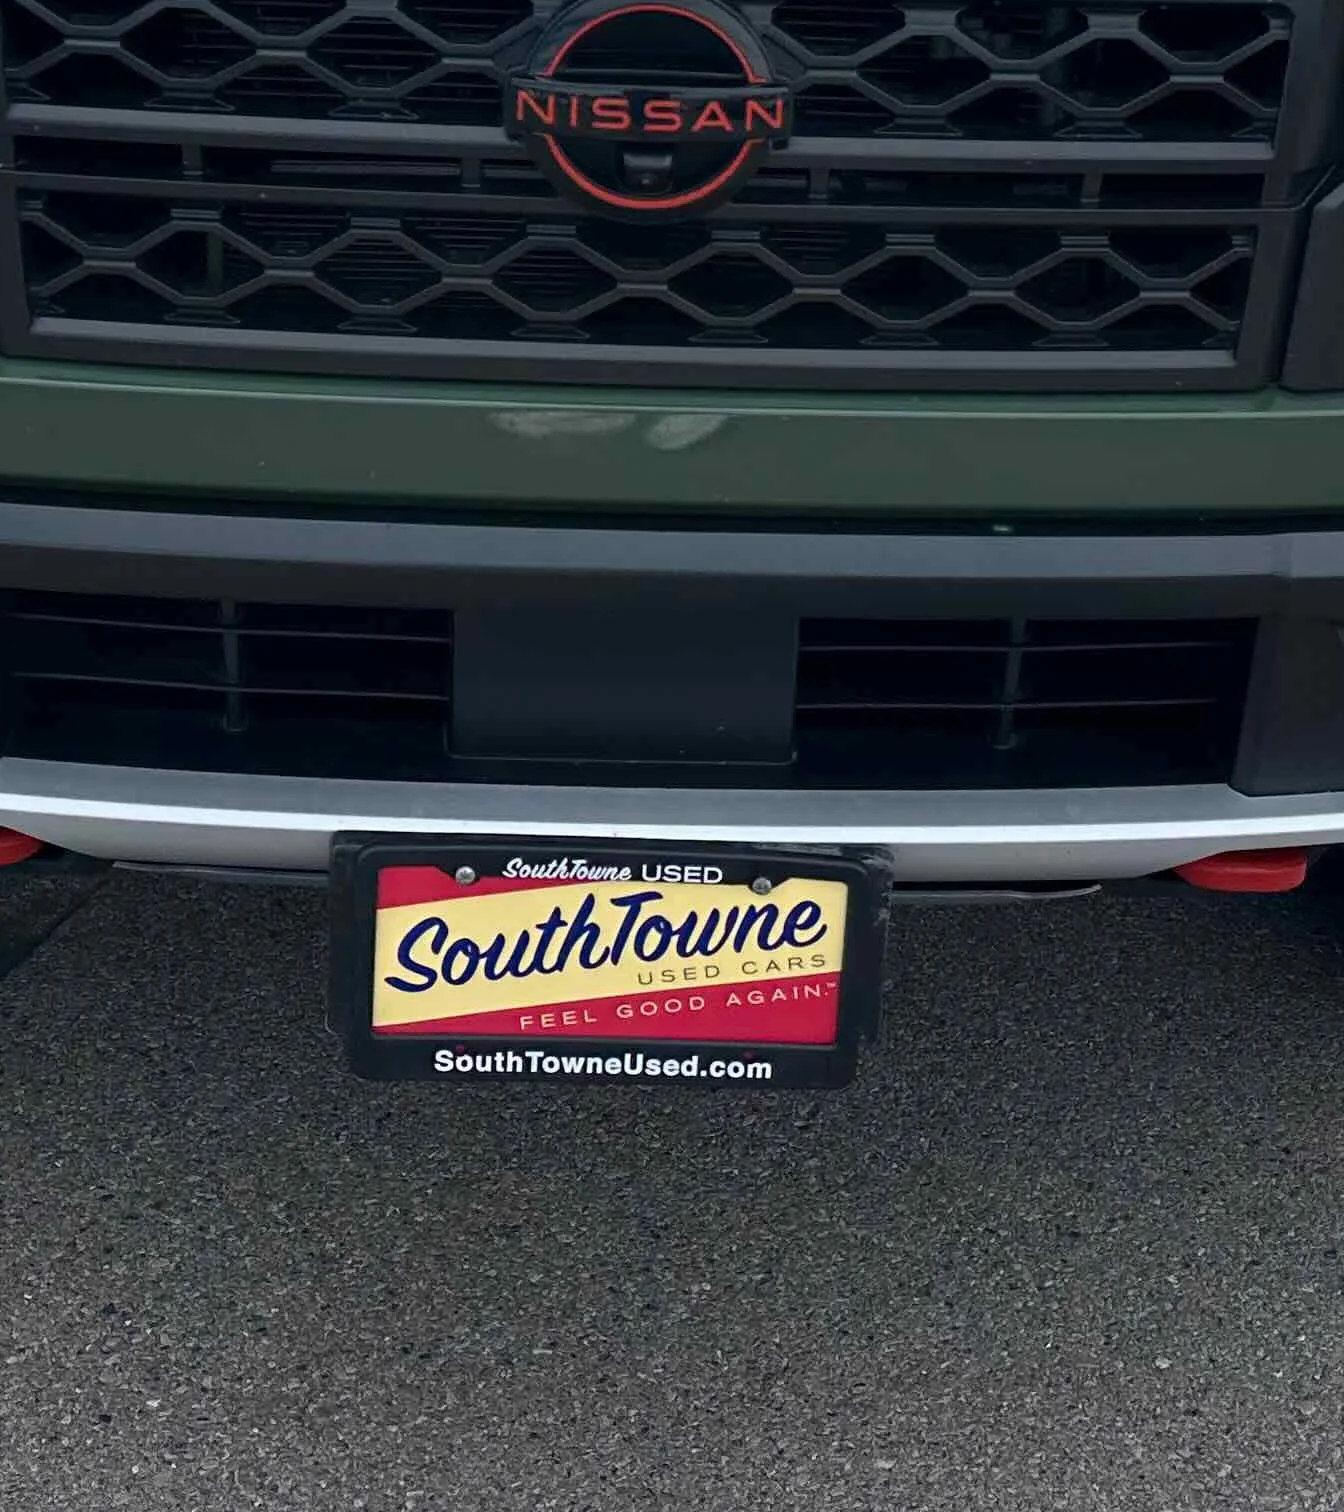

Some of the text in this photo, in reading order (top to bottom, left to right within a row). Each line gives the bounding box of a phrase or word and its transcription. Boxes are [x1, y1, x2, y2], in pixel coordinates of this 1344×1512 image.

[516, 88, 785, 133] NISSAN
[502, 857, 724, 884] SouthTowne USED
[383, 890, 828, 993] SouthTowne
[637, 954, 827, 986] USED CARS
[519, 1008, 597, 1030] FEEL
[616, 995, 706, 1019] GOOD
[433, 1049, 773, 1080] SouthTowneUsed.com
